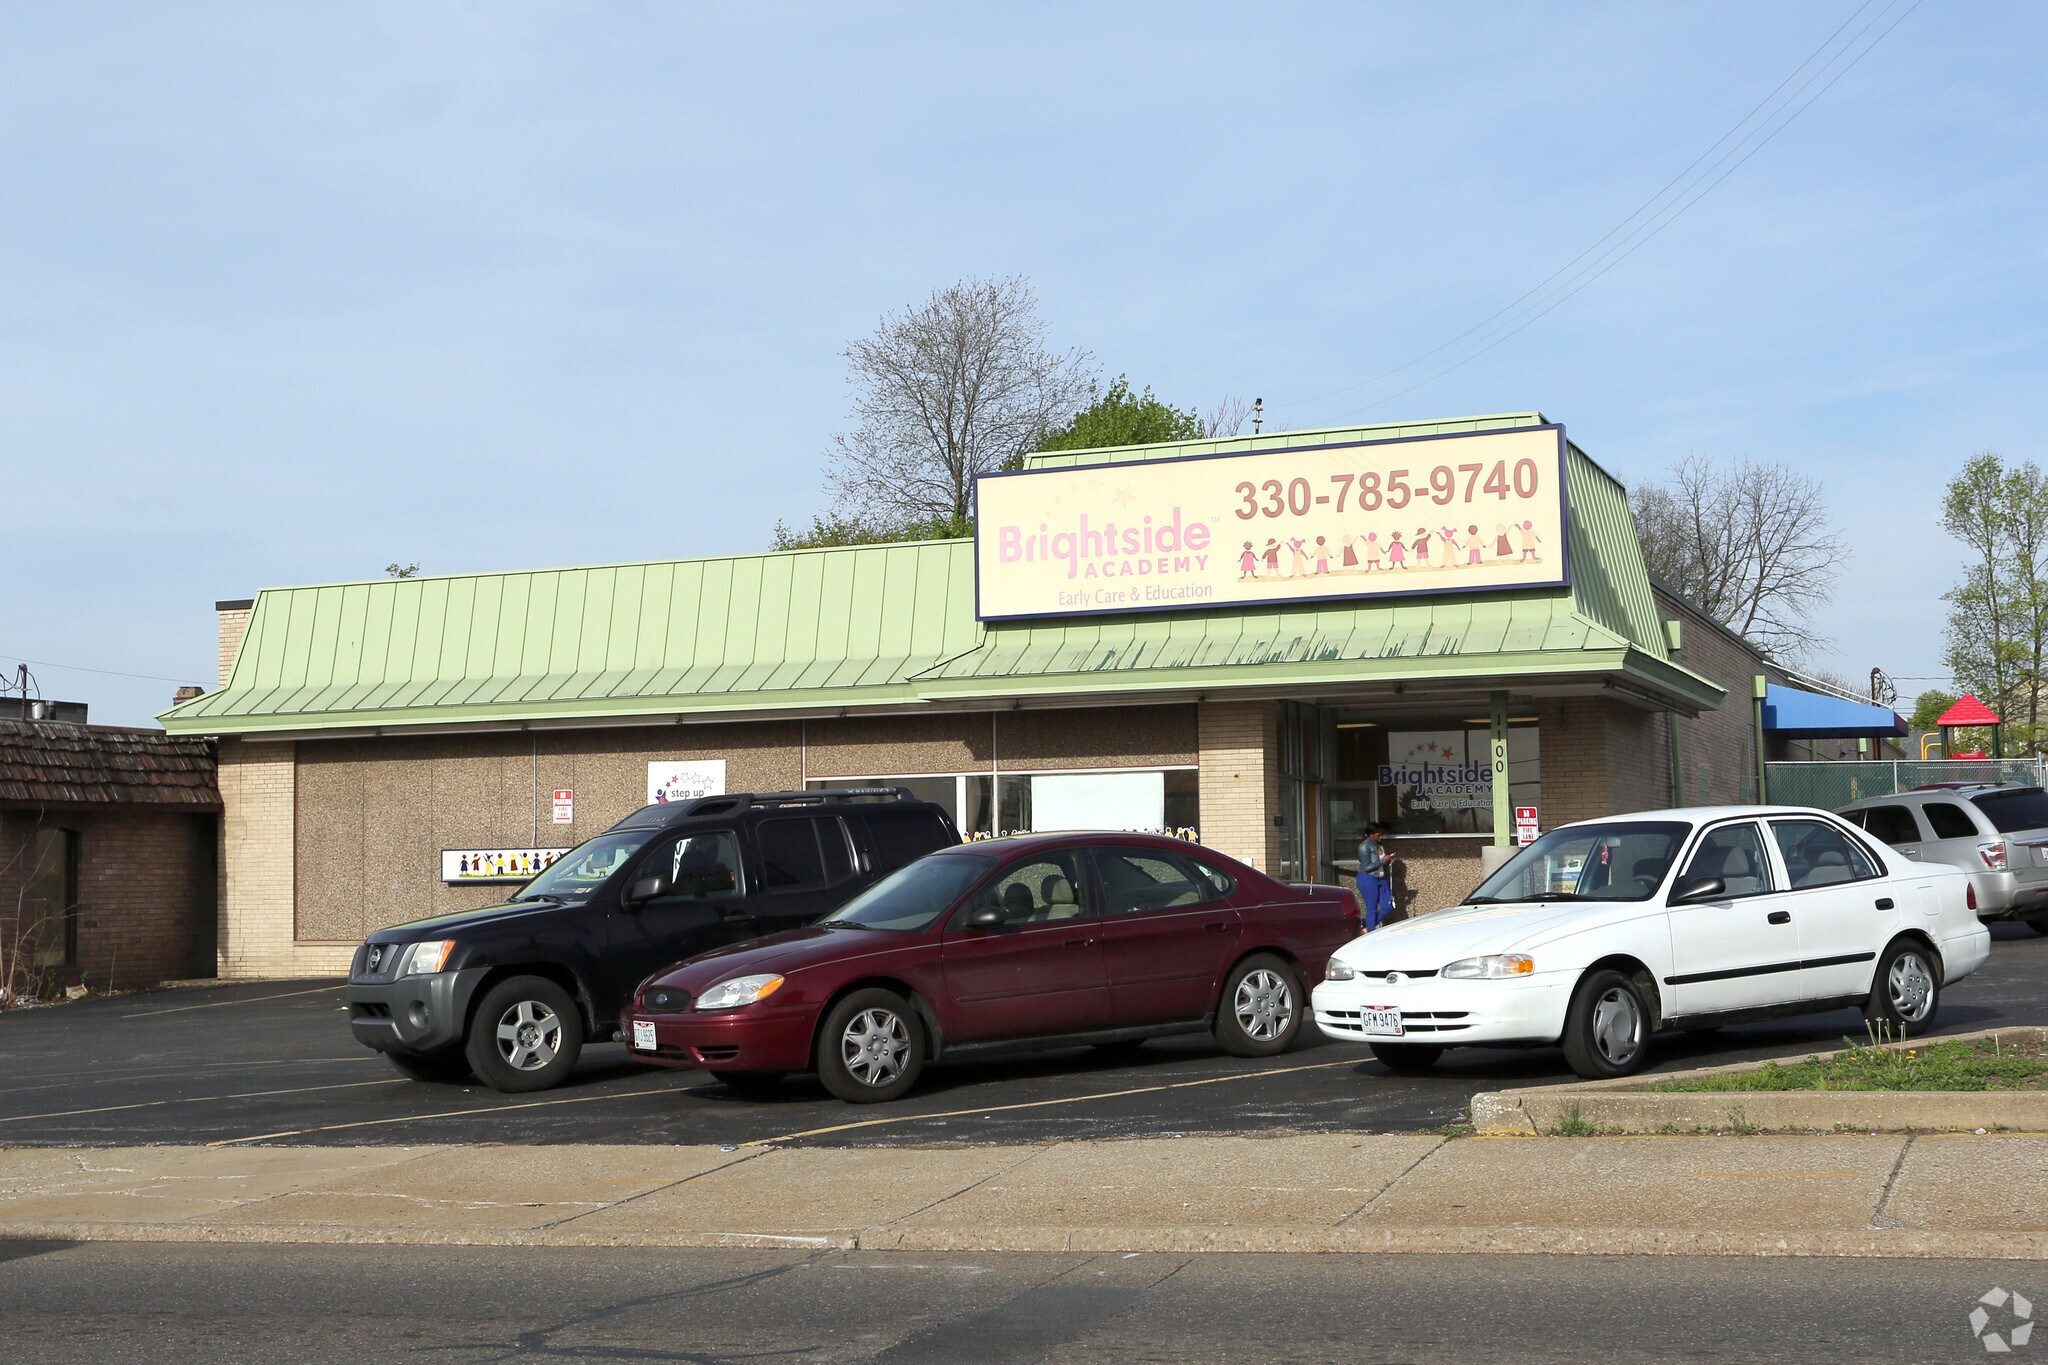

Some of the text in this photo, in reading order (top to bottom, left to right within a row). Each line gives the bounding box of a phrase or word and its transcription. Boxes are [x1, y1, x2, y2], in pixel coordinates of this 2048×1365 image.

[1235, 458, 1538, 520] 330-785-9740
[999, 507, 1211, 579] Brightside
[1084, 555, 1209, 579] ACADEMY
[1058, 583, 1213, 607] Early Care & Education
[1379, 760, 1493, 795] Brightside
[1426, 784, 1493, 795] ACADEMY
[671, 789, 704, 800] step up
[1411, 800, 1430, 810] Early
[1431, 800, 1449, 808] Care
